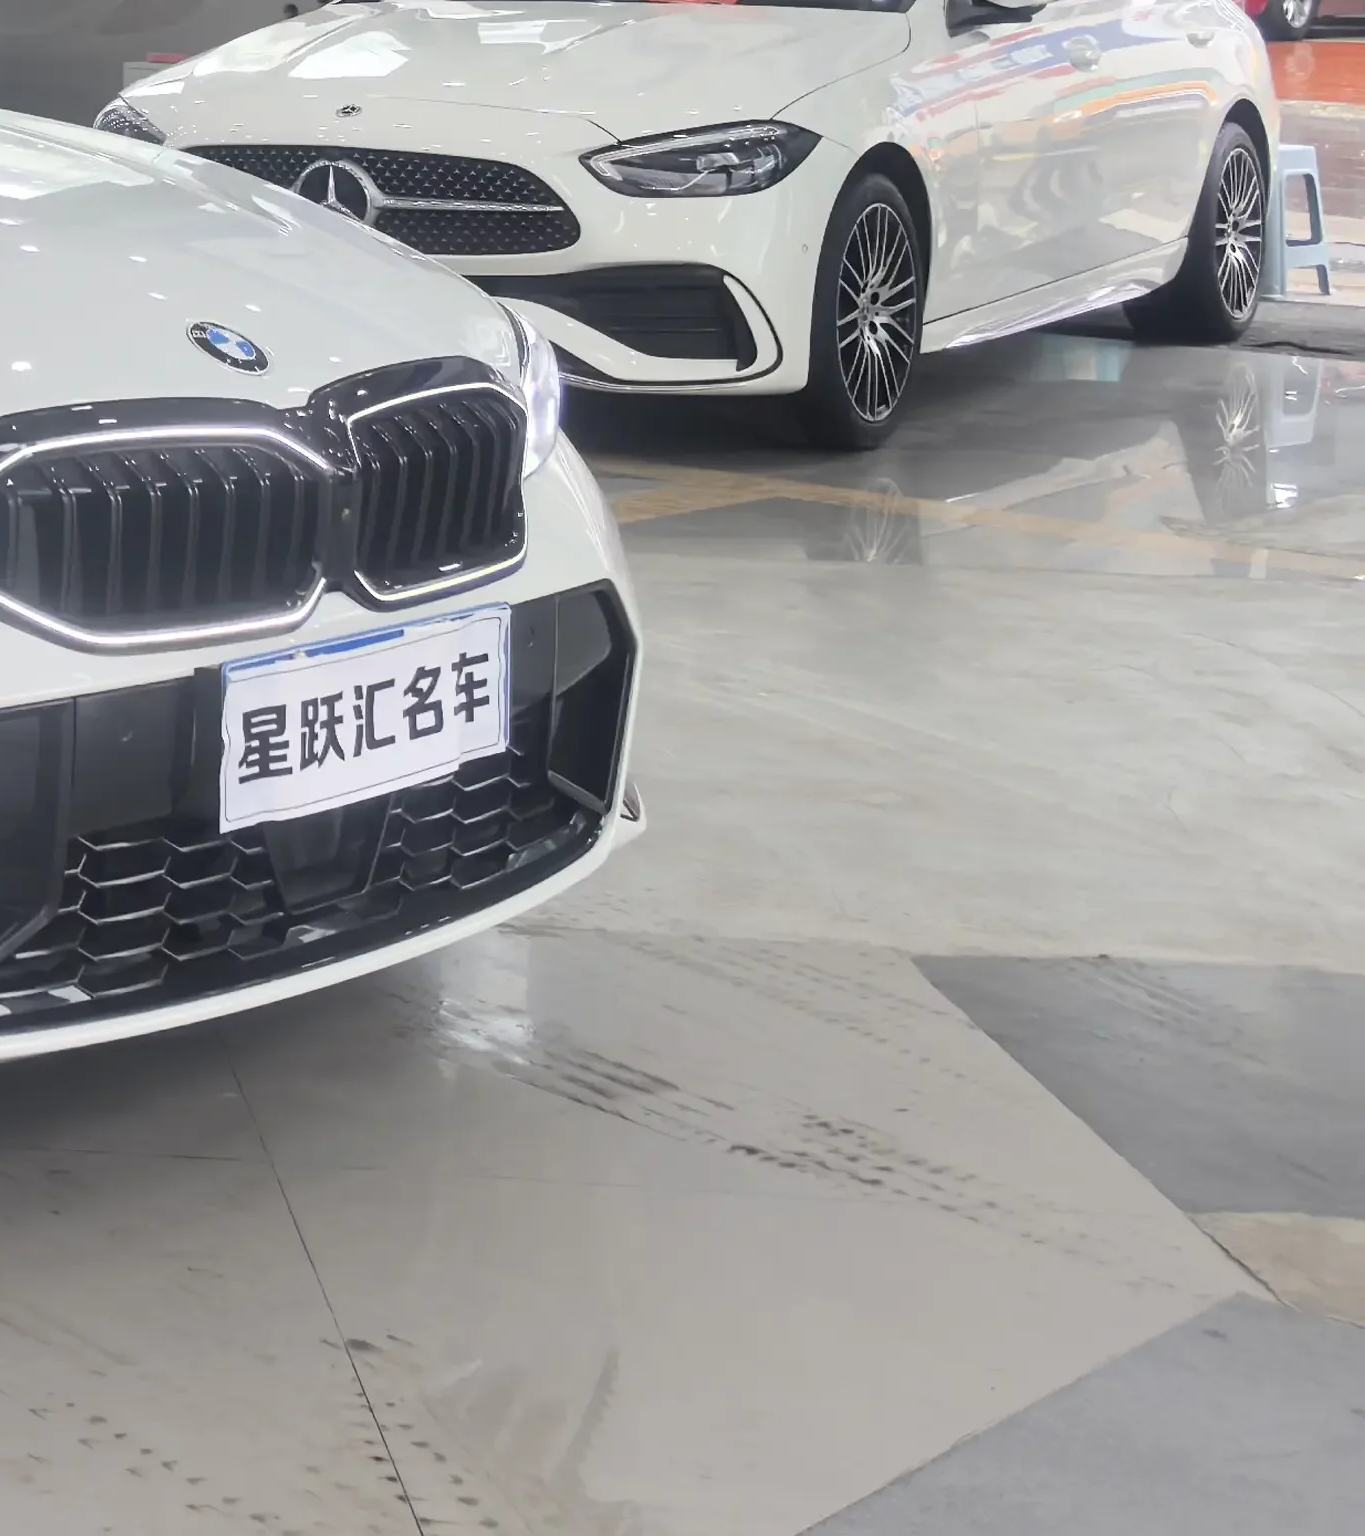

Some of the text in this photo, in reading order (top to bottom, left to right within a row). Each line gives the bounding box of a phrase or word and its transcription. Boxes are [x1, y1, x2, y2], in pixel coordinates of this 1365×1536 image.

[237, 651, 491, 785] 星跃汇名车
